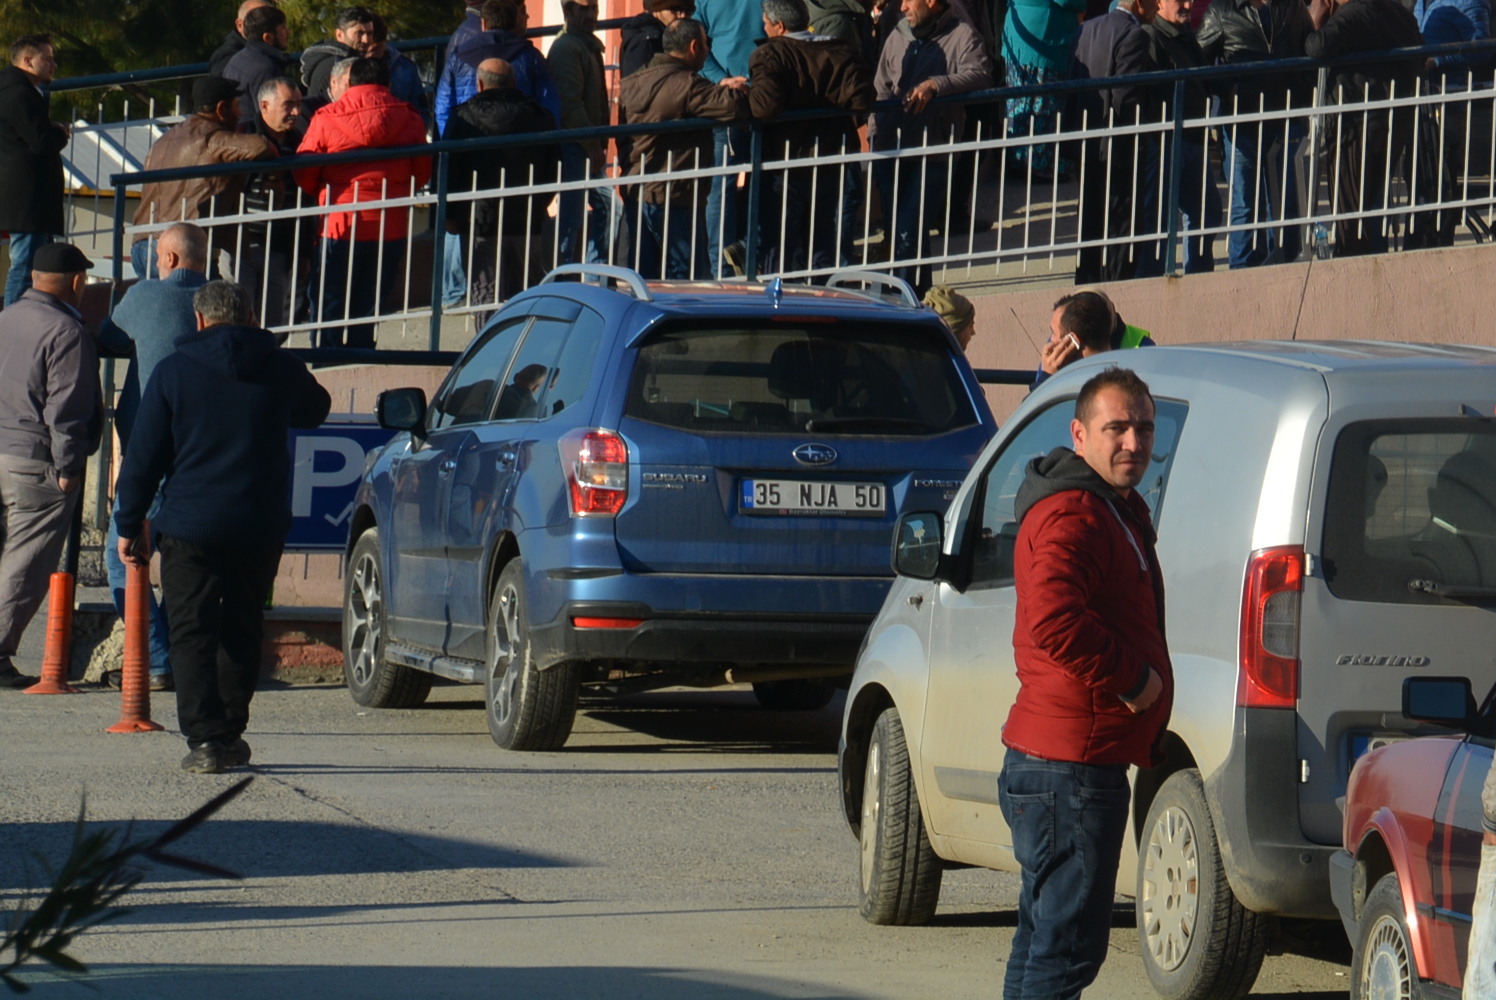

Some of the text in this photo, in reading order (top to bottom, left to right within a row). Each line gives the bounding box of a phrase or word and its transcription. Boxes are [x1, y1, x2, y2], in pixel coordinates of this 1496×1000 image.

[291, 435, 366, 517] P
[643, 472, 707, 484] SUBARU
[743, 495, 753, 503] TR
[755, 483, 880, 508] 35 NJA 50
